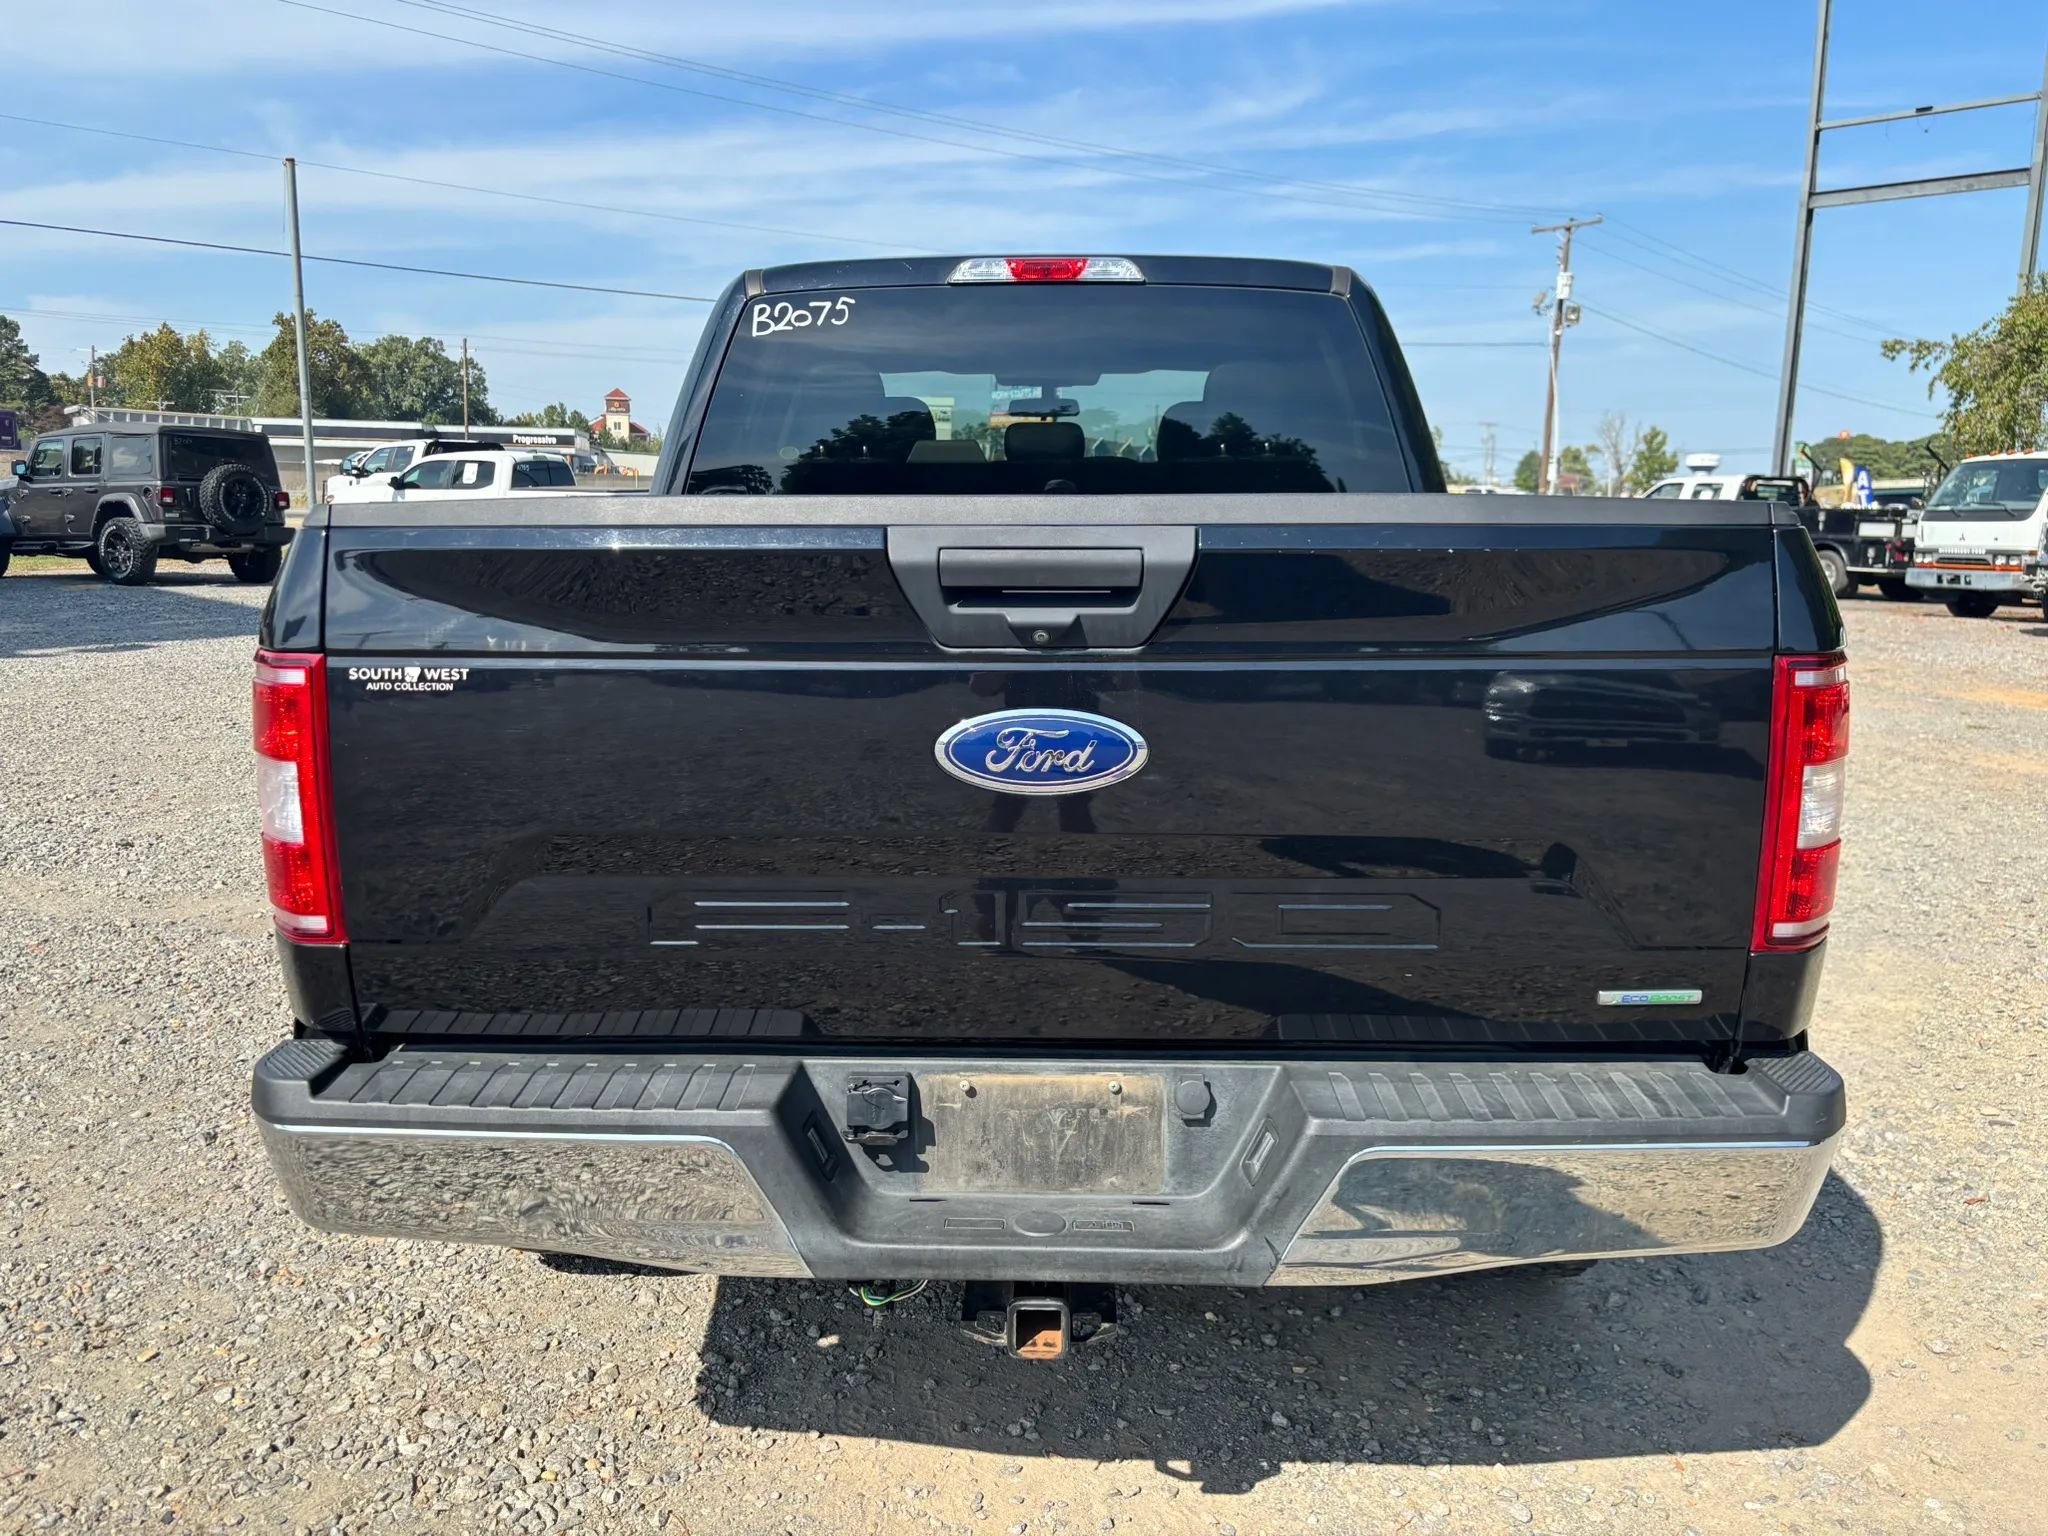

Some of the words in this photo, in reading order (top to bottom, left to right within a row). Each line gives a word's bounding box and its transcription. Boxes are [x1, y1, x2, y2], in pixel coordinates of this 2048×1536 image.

[753, 297, 855, 337] B2075
[512, 434, 556, 445] Progressive
[348, 668, 401, 680] SOUTH
[424, 668, 469, 680] WEST
[366, 682, 392, 691] AUTO
[394, 682, 453, 691] COLLECTION
[985, 727, 1098, 772] Ford
